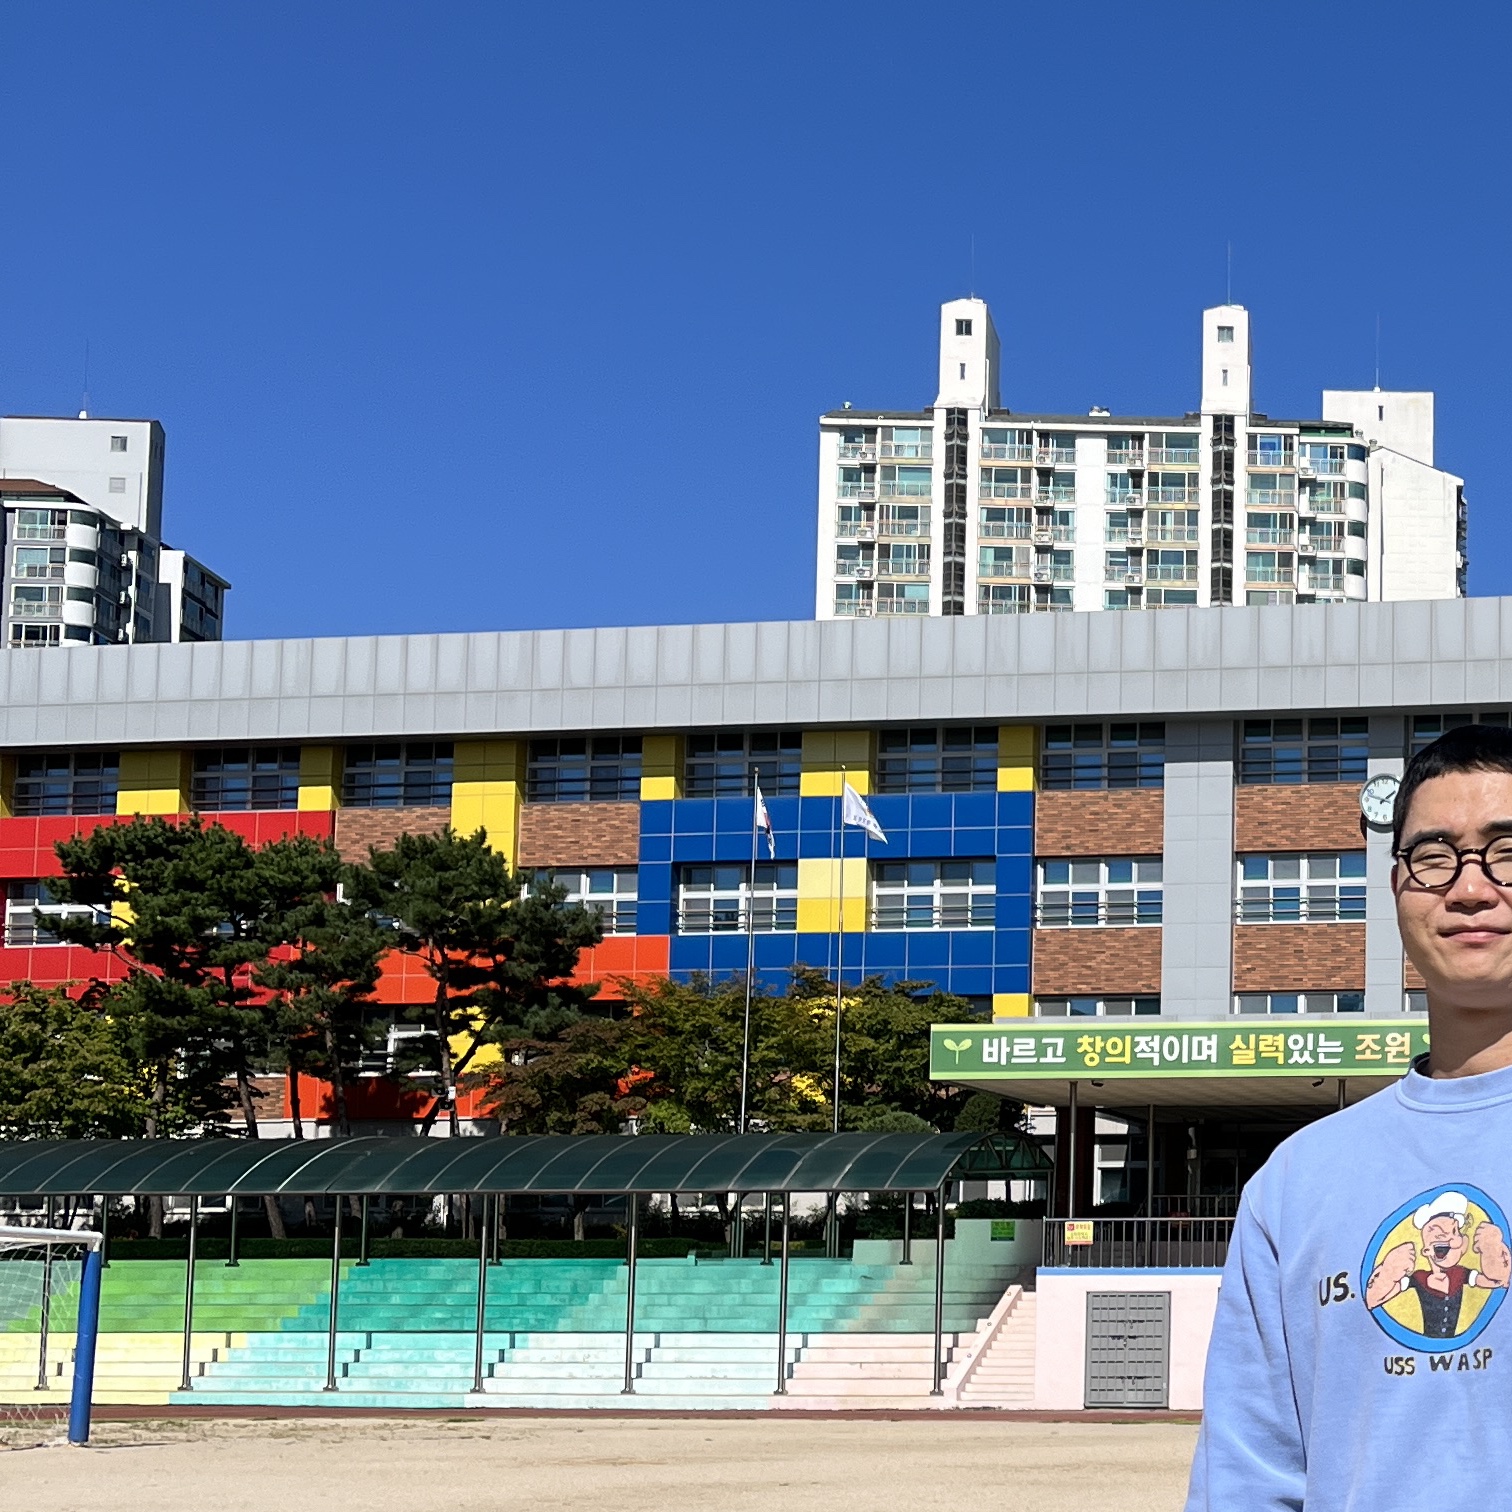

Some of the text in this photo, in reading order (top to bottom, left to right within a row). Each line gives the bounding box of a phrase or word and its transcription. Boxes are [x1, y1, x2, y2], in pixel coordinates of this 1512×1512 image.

[982, 1032, 1411, 1067] 바르고 창의적이며 실력있는 조원
[1383, 1348, 1493, 1376] USS WASP
